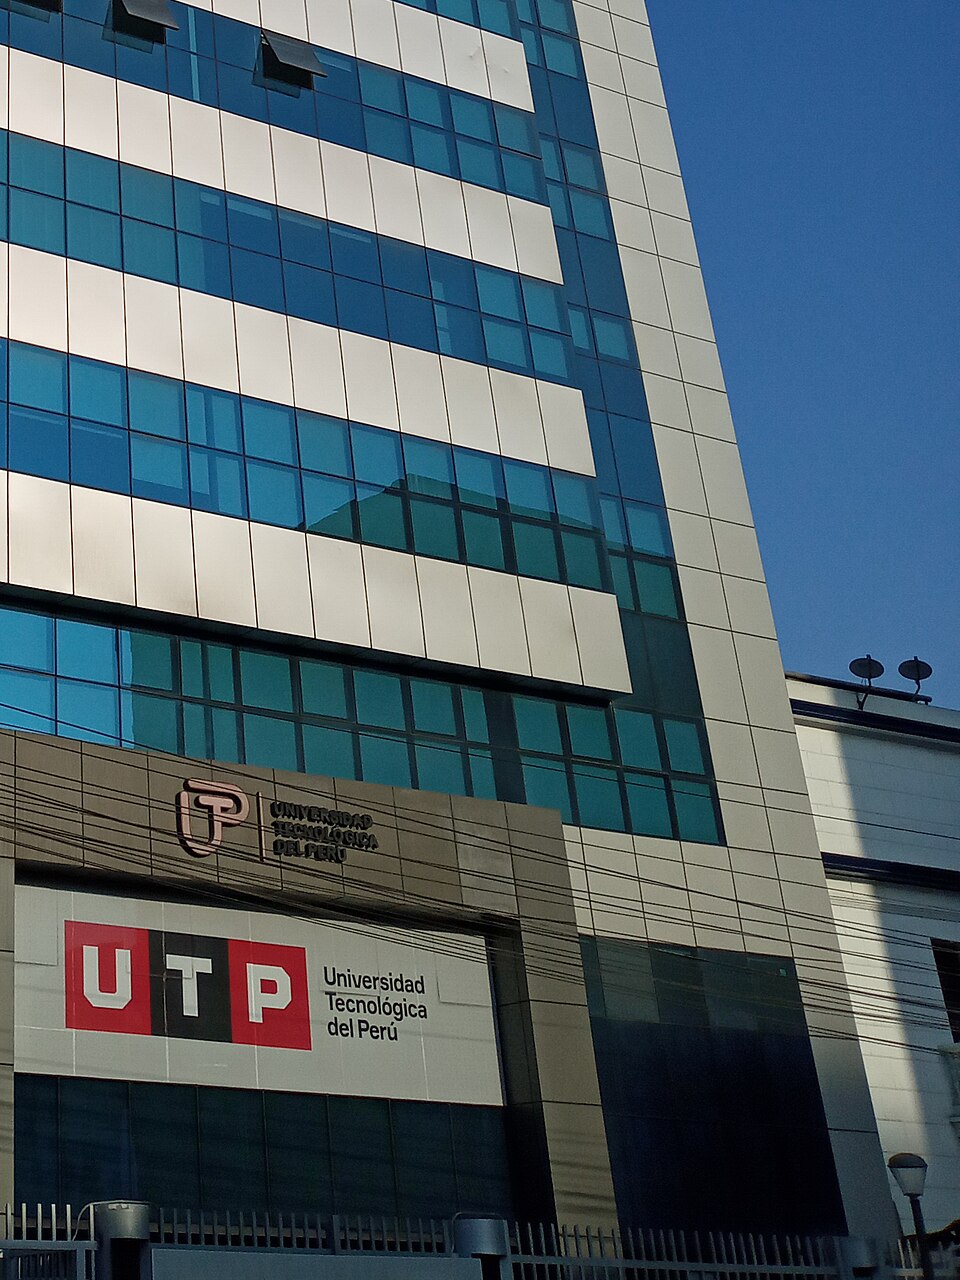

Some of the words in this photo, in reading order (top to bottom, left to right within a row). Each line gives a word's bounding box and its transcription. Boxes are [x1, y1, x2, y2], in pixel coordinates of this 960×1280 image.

[270, 801, 373, 830] UNIVERSIDAD
[273, 839, 304, 857] DEL
[82, 944, 292, 1024] UTP
[323, 966, 425, 994] Universidad
[324, 991, 428, 1022] Tecnológica
[327, 1016, 354, 1038] del
[357, 1019, 398, 1041] Perú
